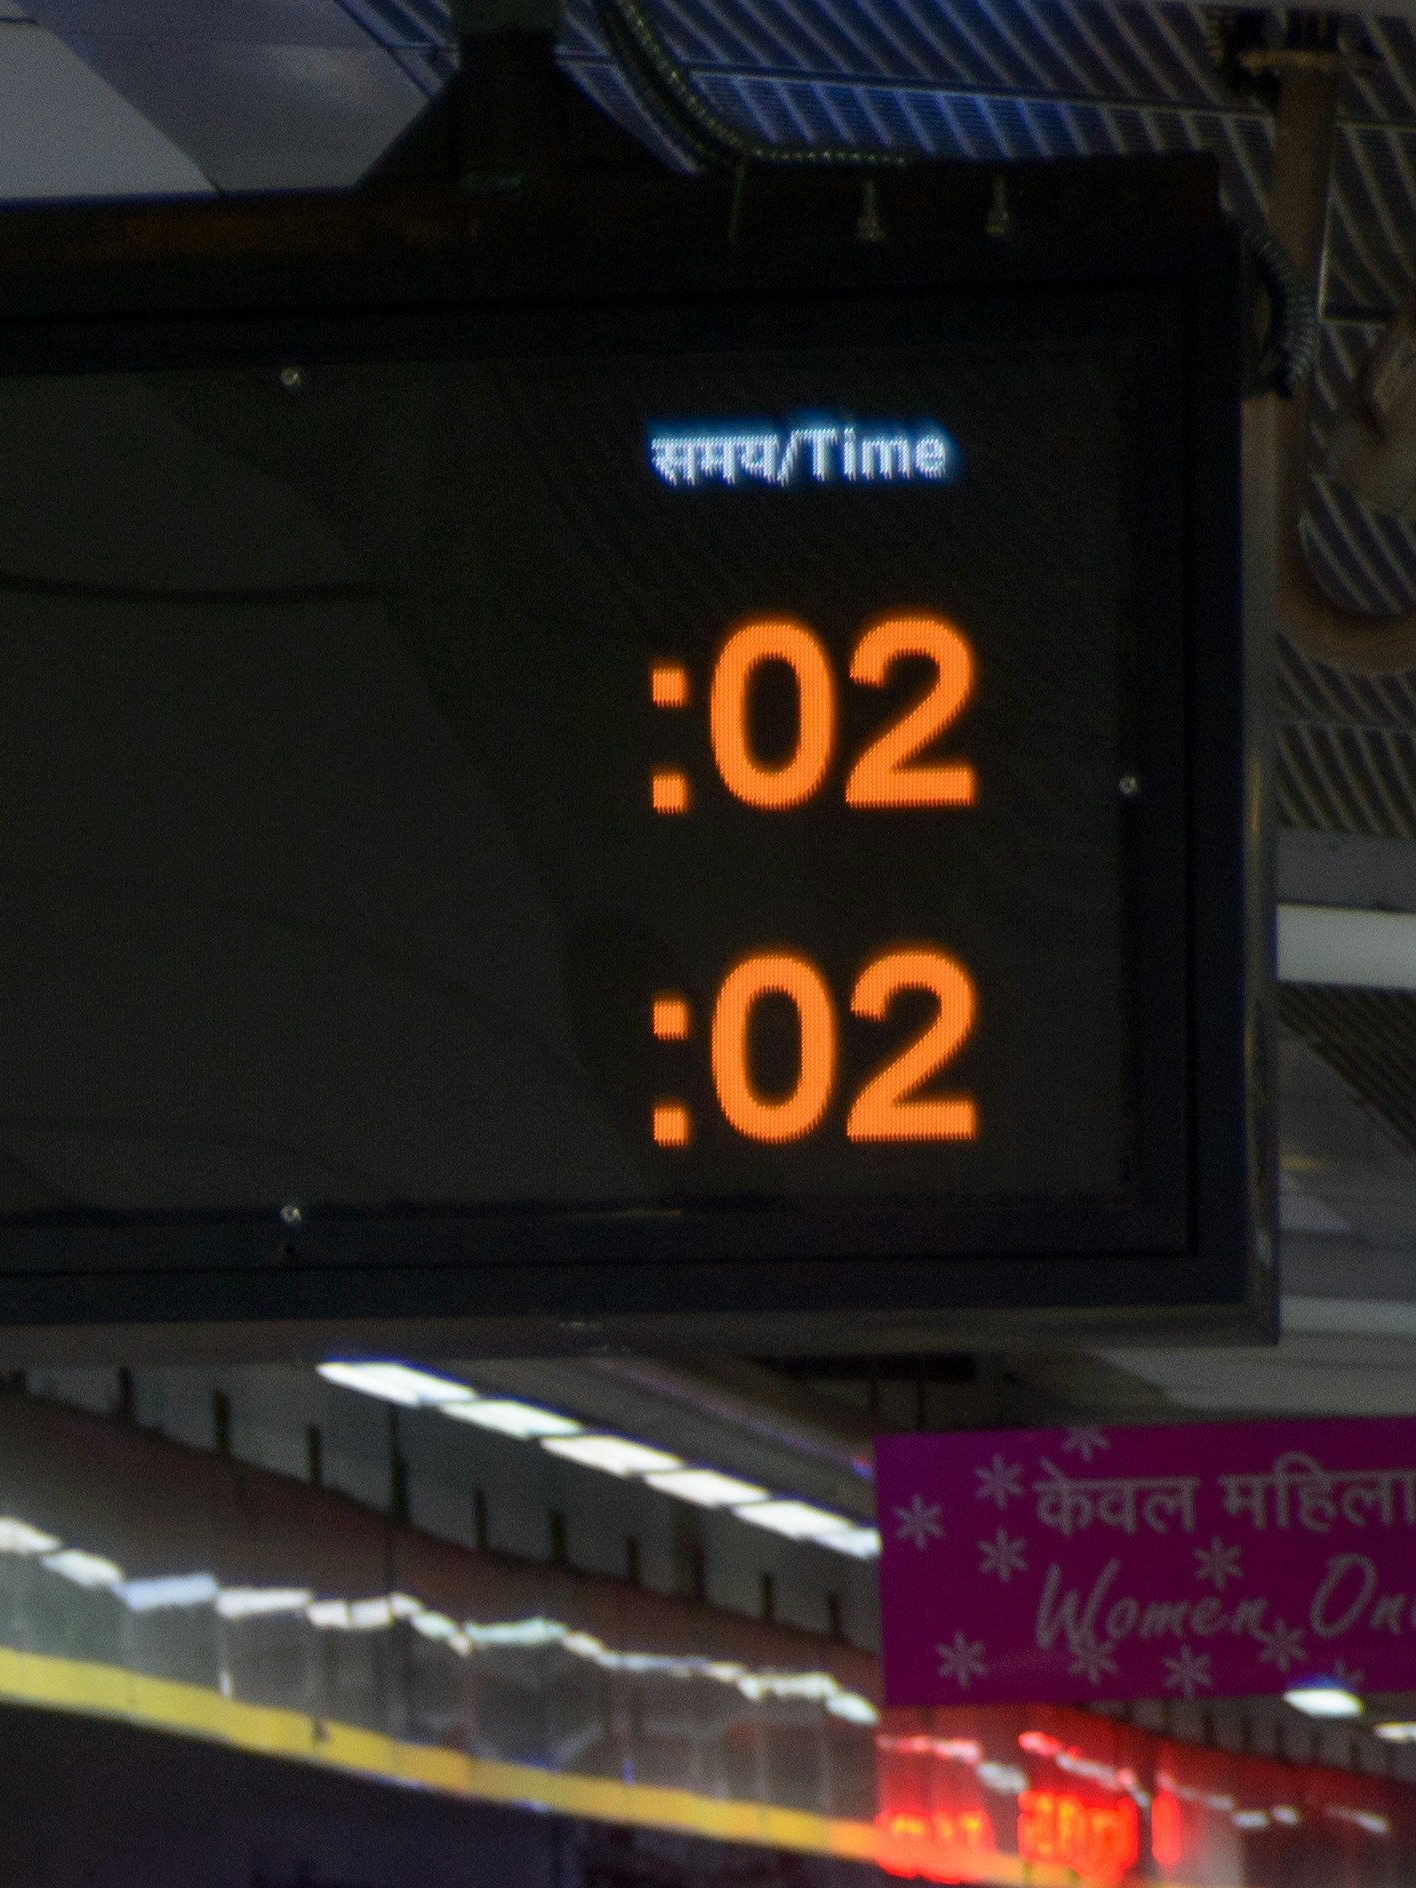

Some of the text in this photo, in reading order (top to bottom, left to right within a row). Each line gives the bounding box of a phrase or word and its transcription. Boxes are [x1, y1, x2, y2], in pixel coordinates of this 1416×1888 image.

[651, 426, 947, 486] समय/Time
[651, 617, 977, 814] :02
[651, 951, 977, 1145] :02
[1031, 1456, 1200, 1536] केवल
[1036, 1553, 1416, 1652] Women On
